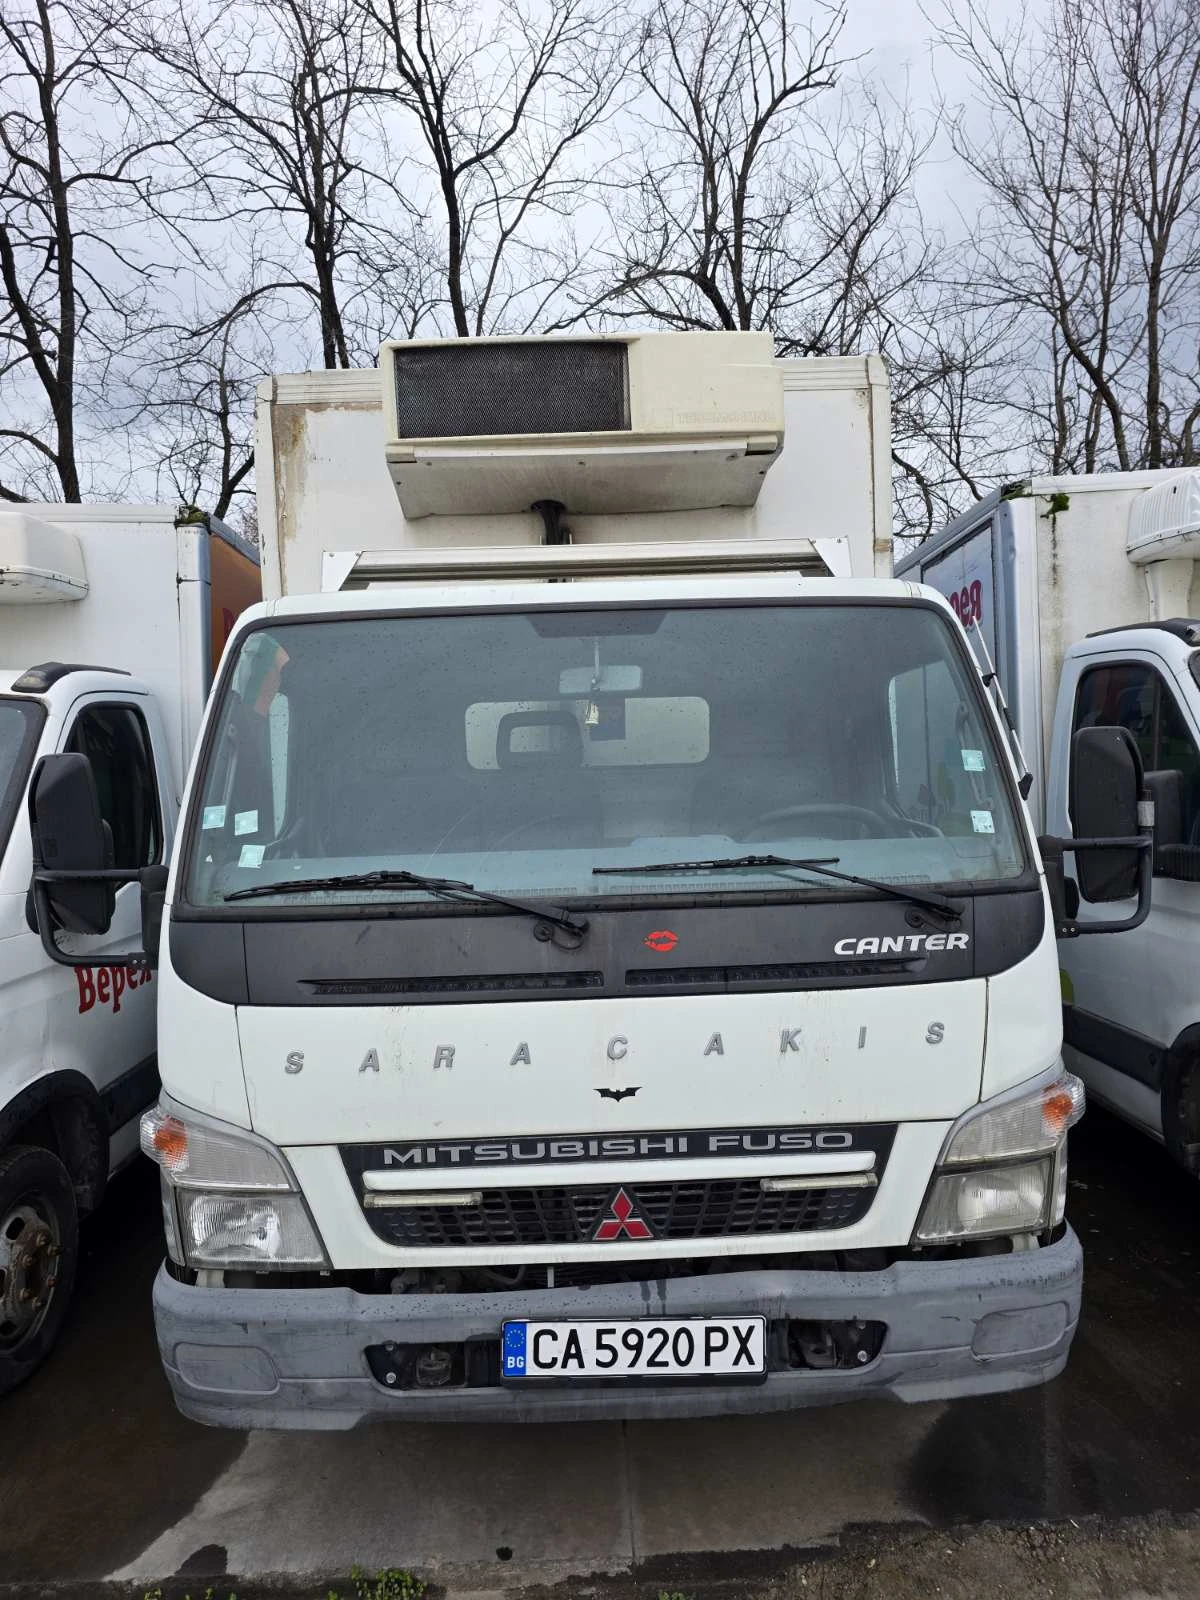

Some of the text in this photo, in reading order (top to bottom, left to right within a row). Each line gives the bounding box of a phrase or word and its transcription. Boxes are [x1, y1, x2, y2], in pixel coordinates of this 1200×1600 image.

[834, 933, 970, 955] CANTER
[284, 1022, 945, 1074] SARACAKIS
[384, 1132, 853, 1165] MITSUBISHI FUSO
[507, 1356, 524, 1369] BG
[533, 1325, 755, 1369] CA 5920 PX
